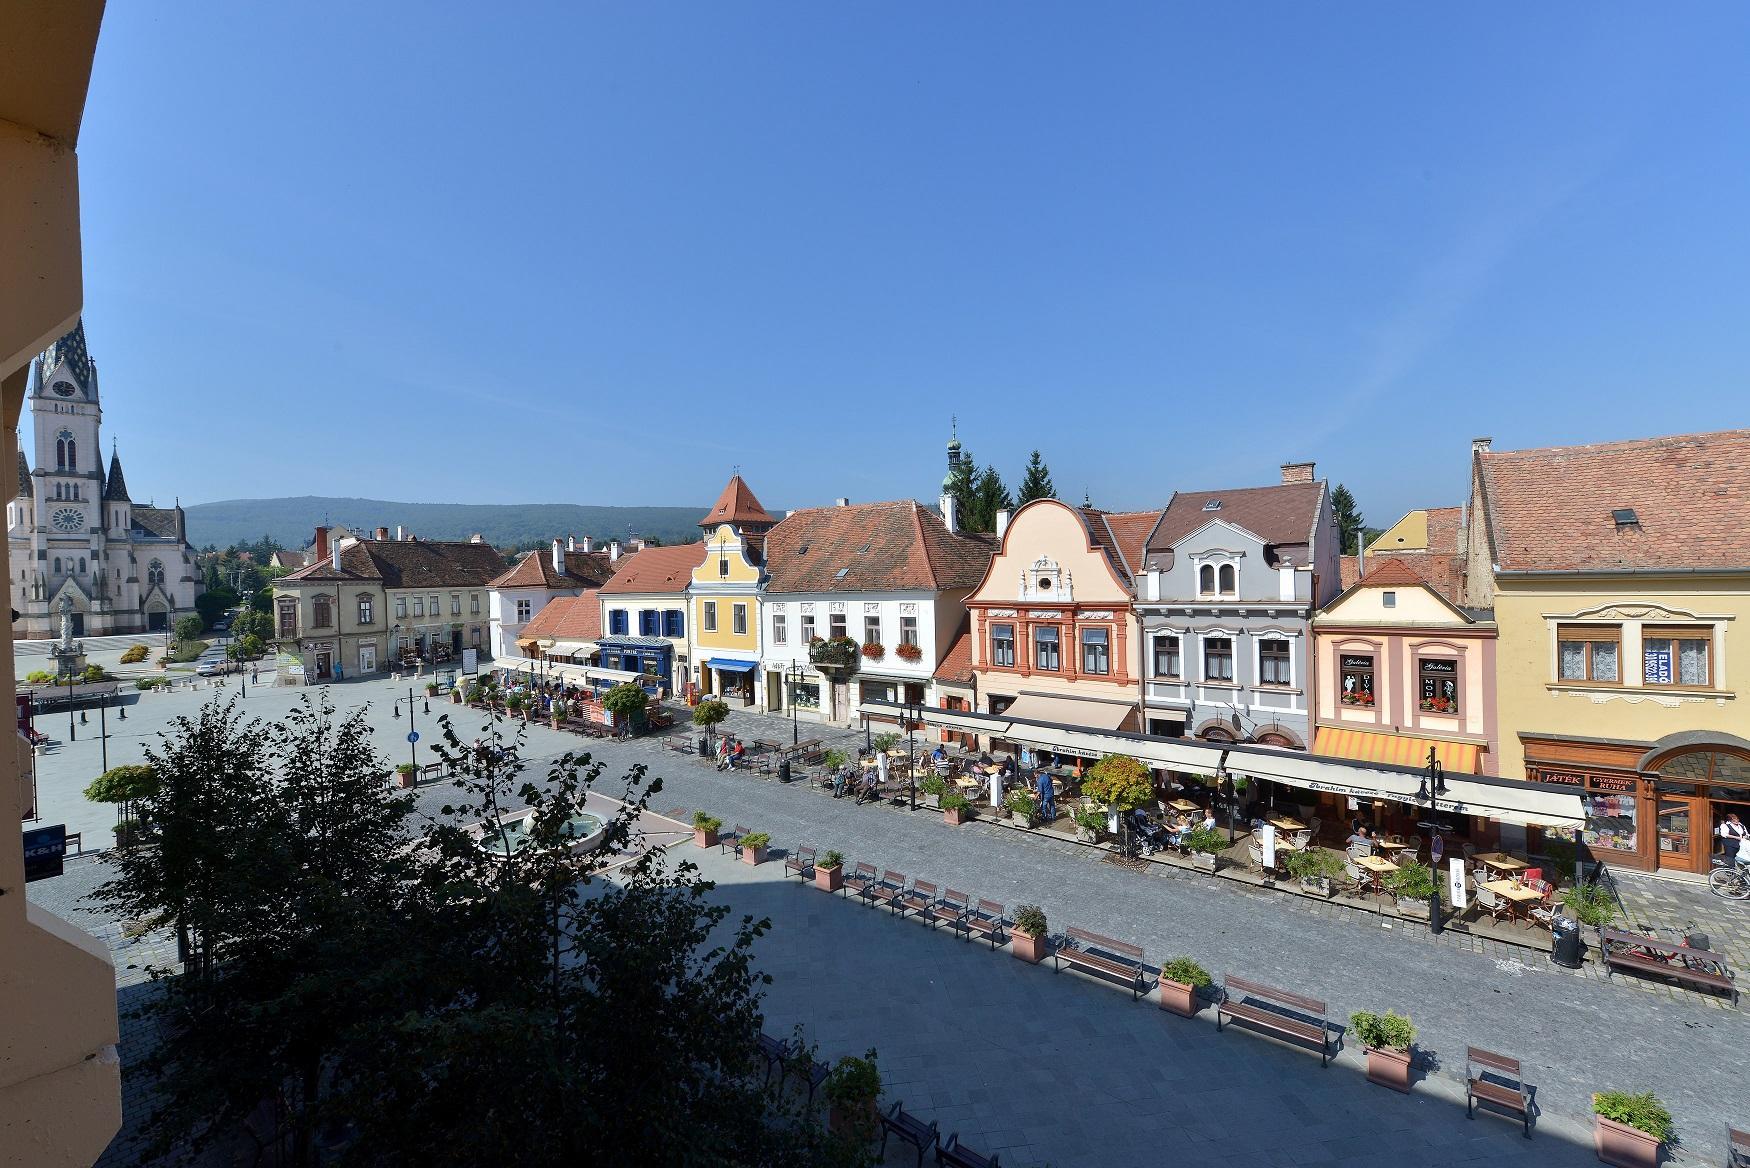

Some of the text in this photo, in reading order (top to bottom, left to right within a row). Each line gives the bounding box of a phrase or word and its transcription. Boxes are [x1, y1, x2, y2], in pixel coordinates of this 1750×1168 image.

[1658, 654, 1670, 684] ELADÓ
[1545, 773, 1582, 784] JÁTÉK
[1599, 783, 1627, 791] RUHA
[25, 844, 63, 857] K&H
